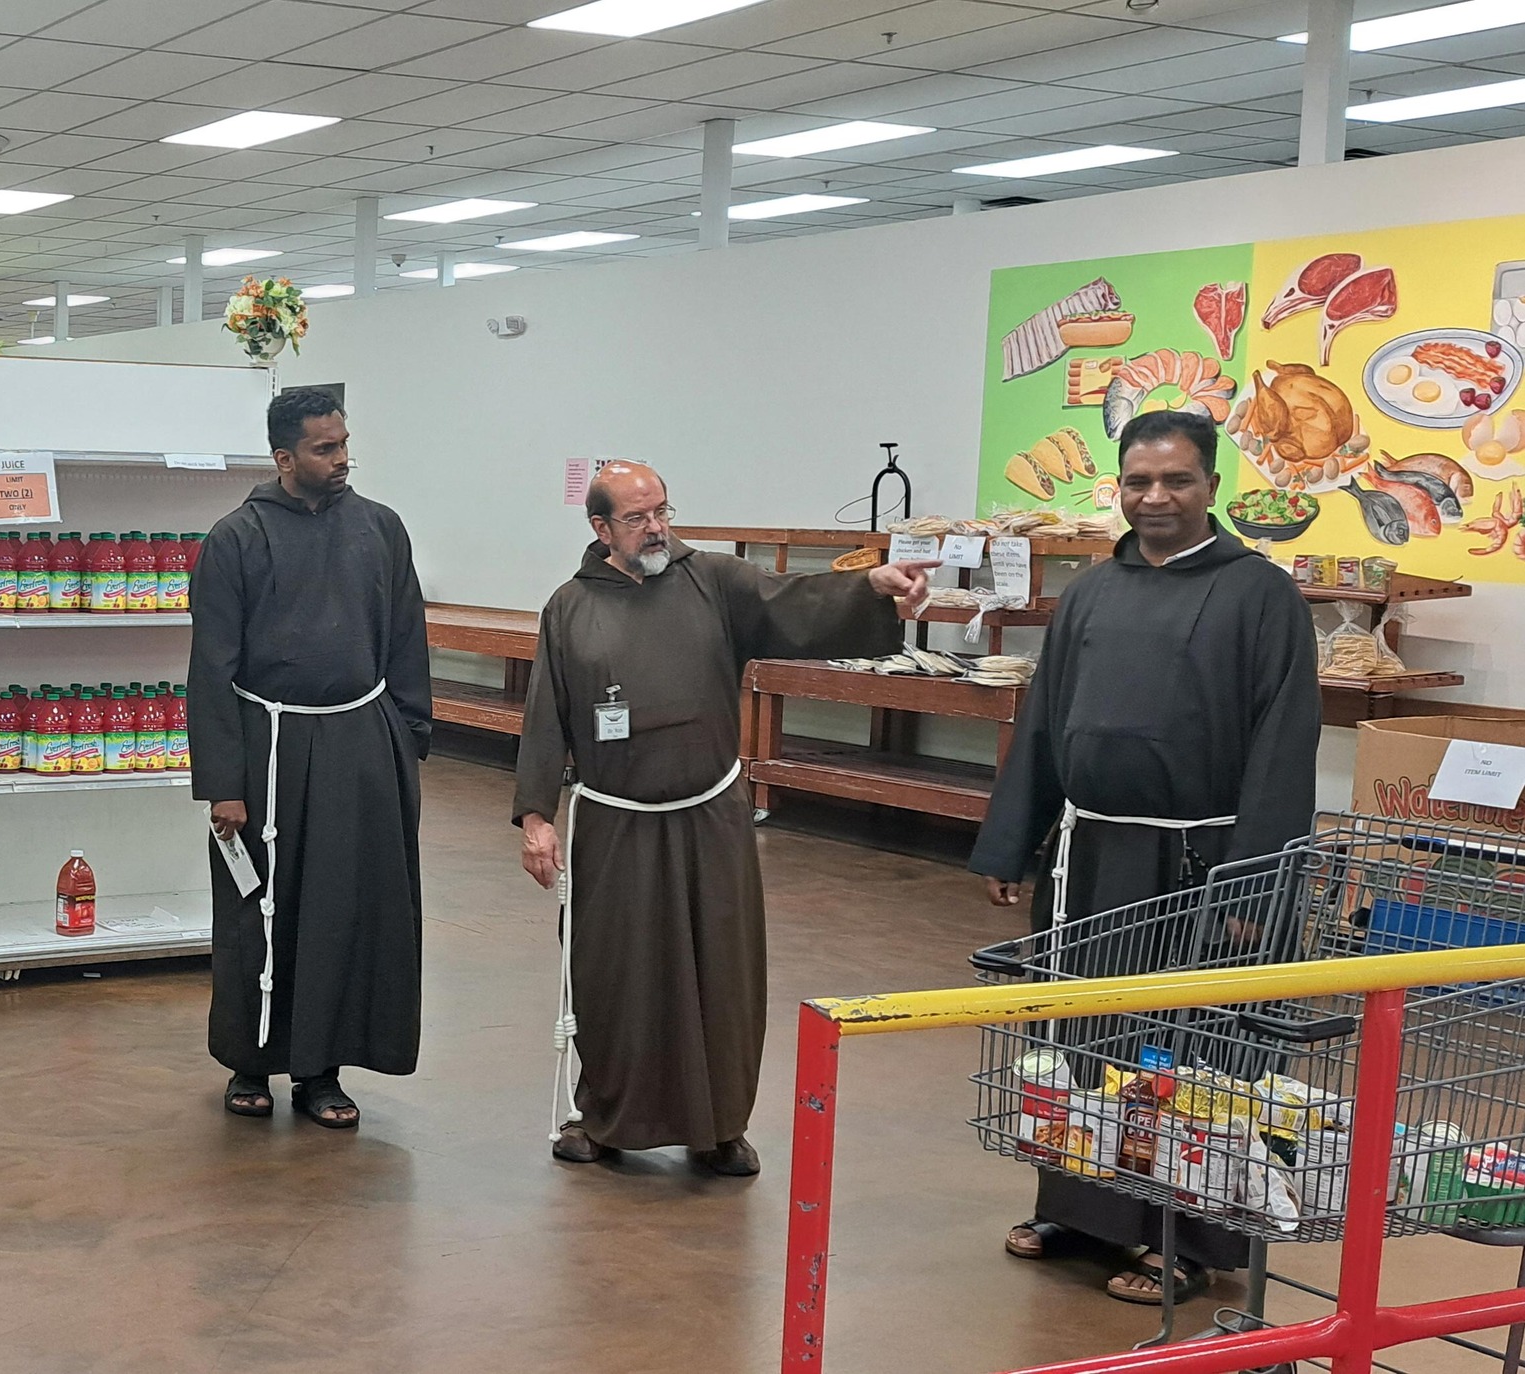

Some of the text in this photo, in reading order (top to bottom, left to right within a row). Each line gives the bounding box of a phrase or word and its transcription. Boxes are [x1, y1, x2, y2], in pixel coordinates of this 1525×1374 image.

[1, 460, 25, 470] JUICE
[0, 488, 33, 498] TWO (2)
[1464, 768, 1502, 778] ITEM LIMIT
